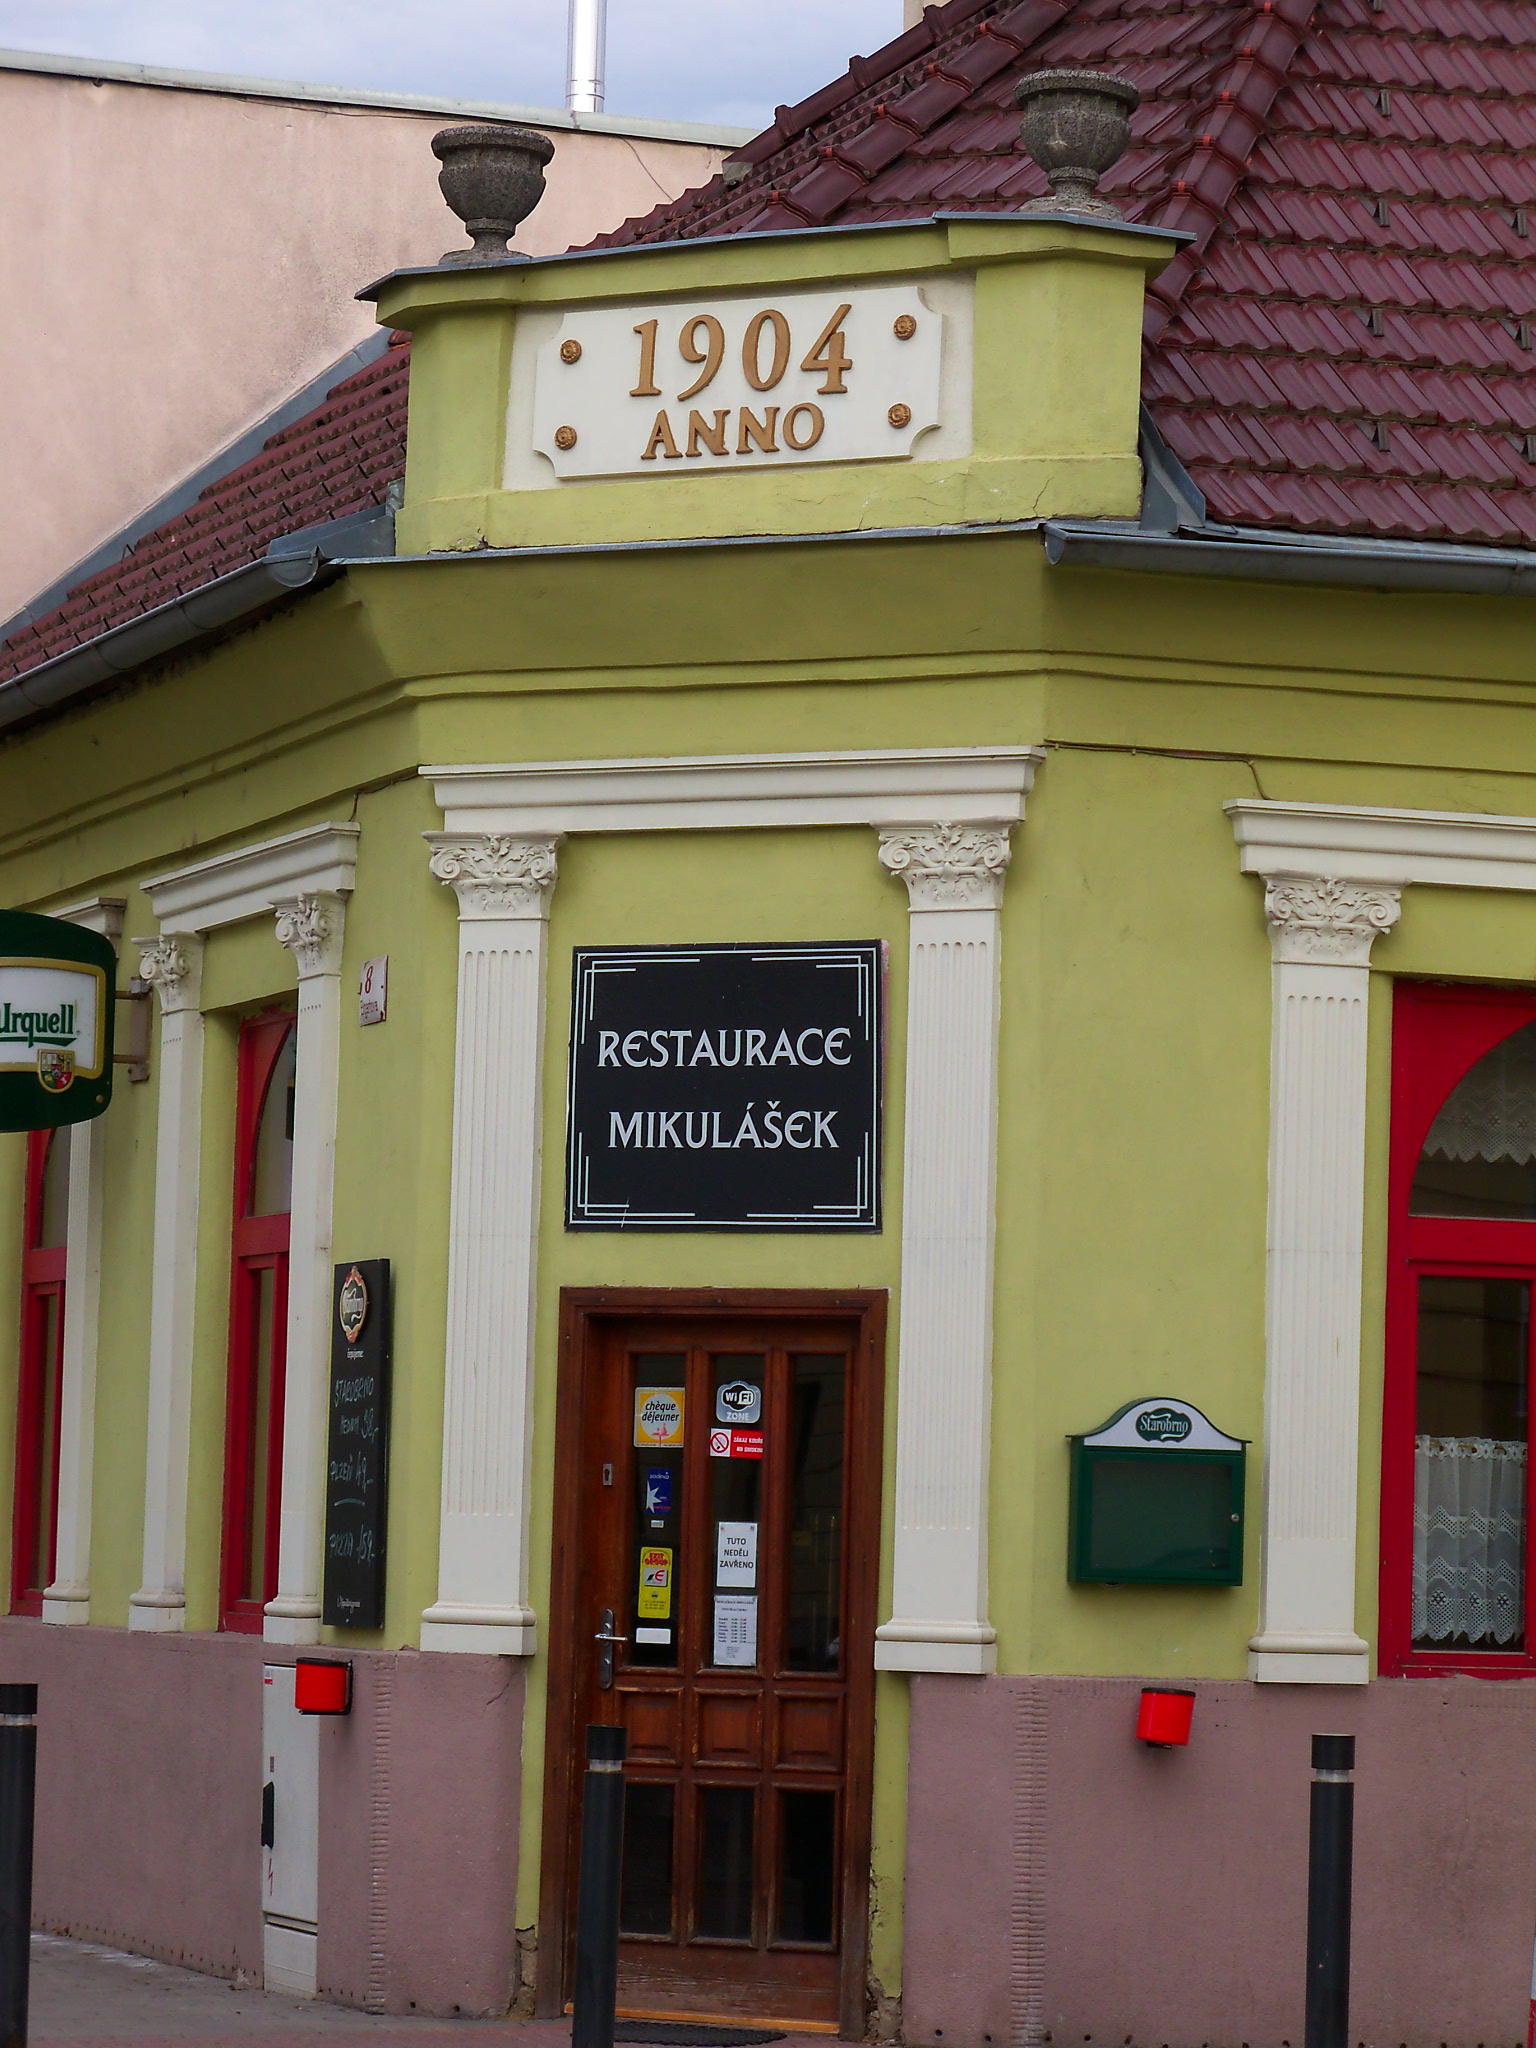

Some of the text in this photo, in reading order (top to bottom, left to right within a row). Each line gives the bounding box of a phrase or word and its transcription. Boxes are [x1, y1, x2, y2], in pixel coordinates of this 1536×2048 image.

[629, 304, 852, 401] 1904
[641, 403, 824, 460] ANNO
[597, 1027, 852, 1068] RESTAURACE
[607, 1101, 839, 1148] MIKULÁŠEK
[645, 1401, 676, 1412] chèque
[641, 1411, 680, 1423] déjeuner
[1139, 1414, 1189, 1434] Starobrno
[727, 1537, 747, 1546] TUTO
[724, 1548, 749, 1557] NEDĚLI
[720, 1559, 754, 1569] ZAVŘENO
